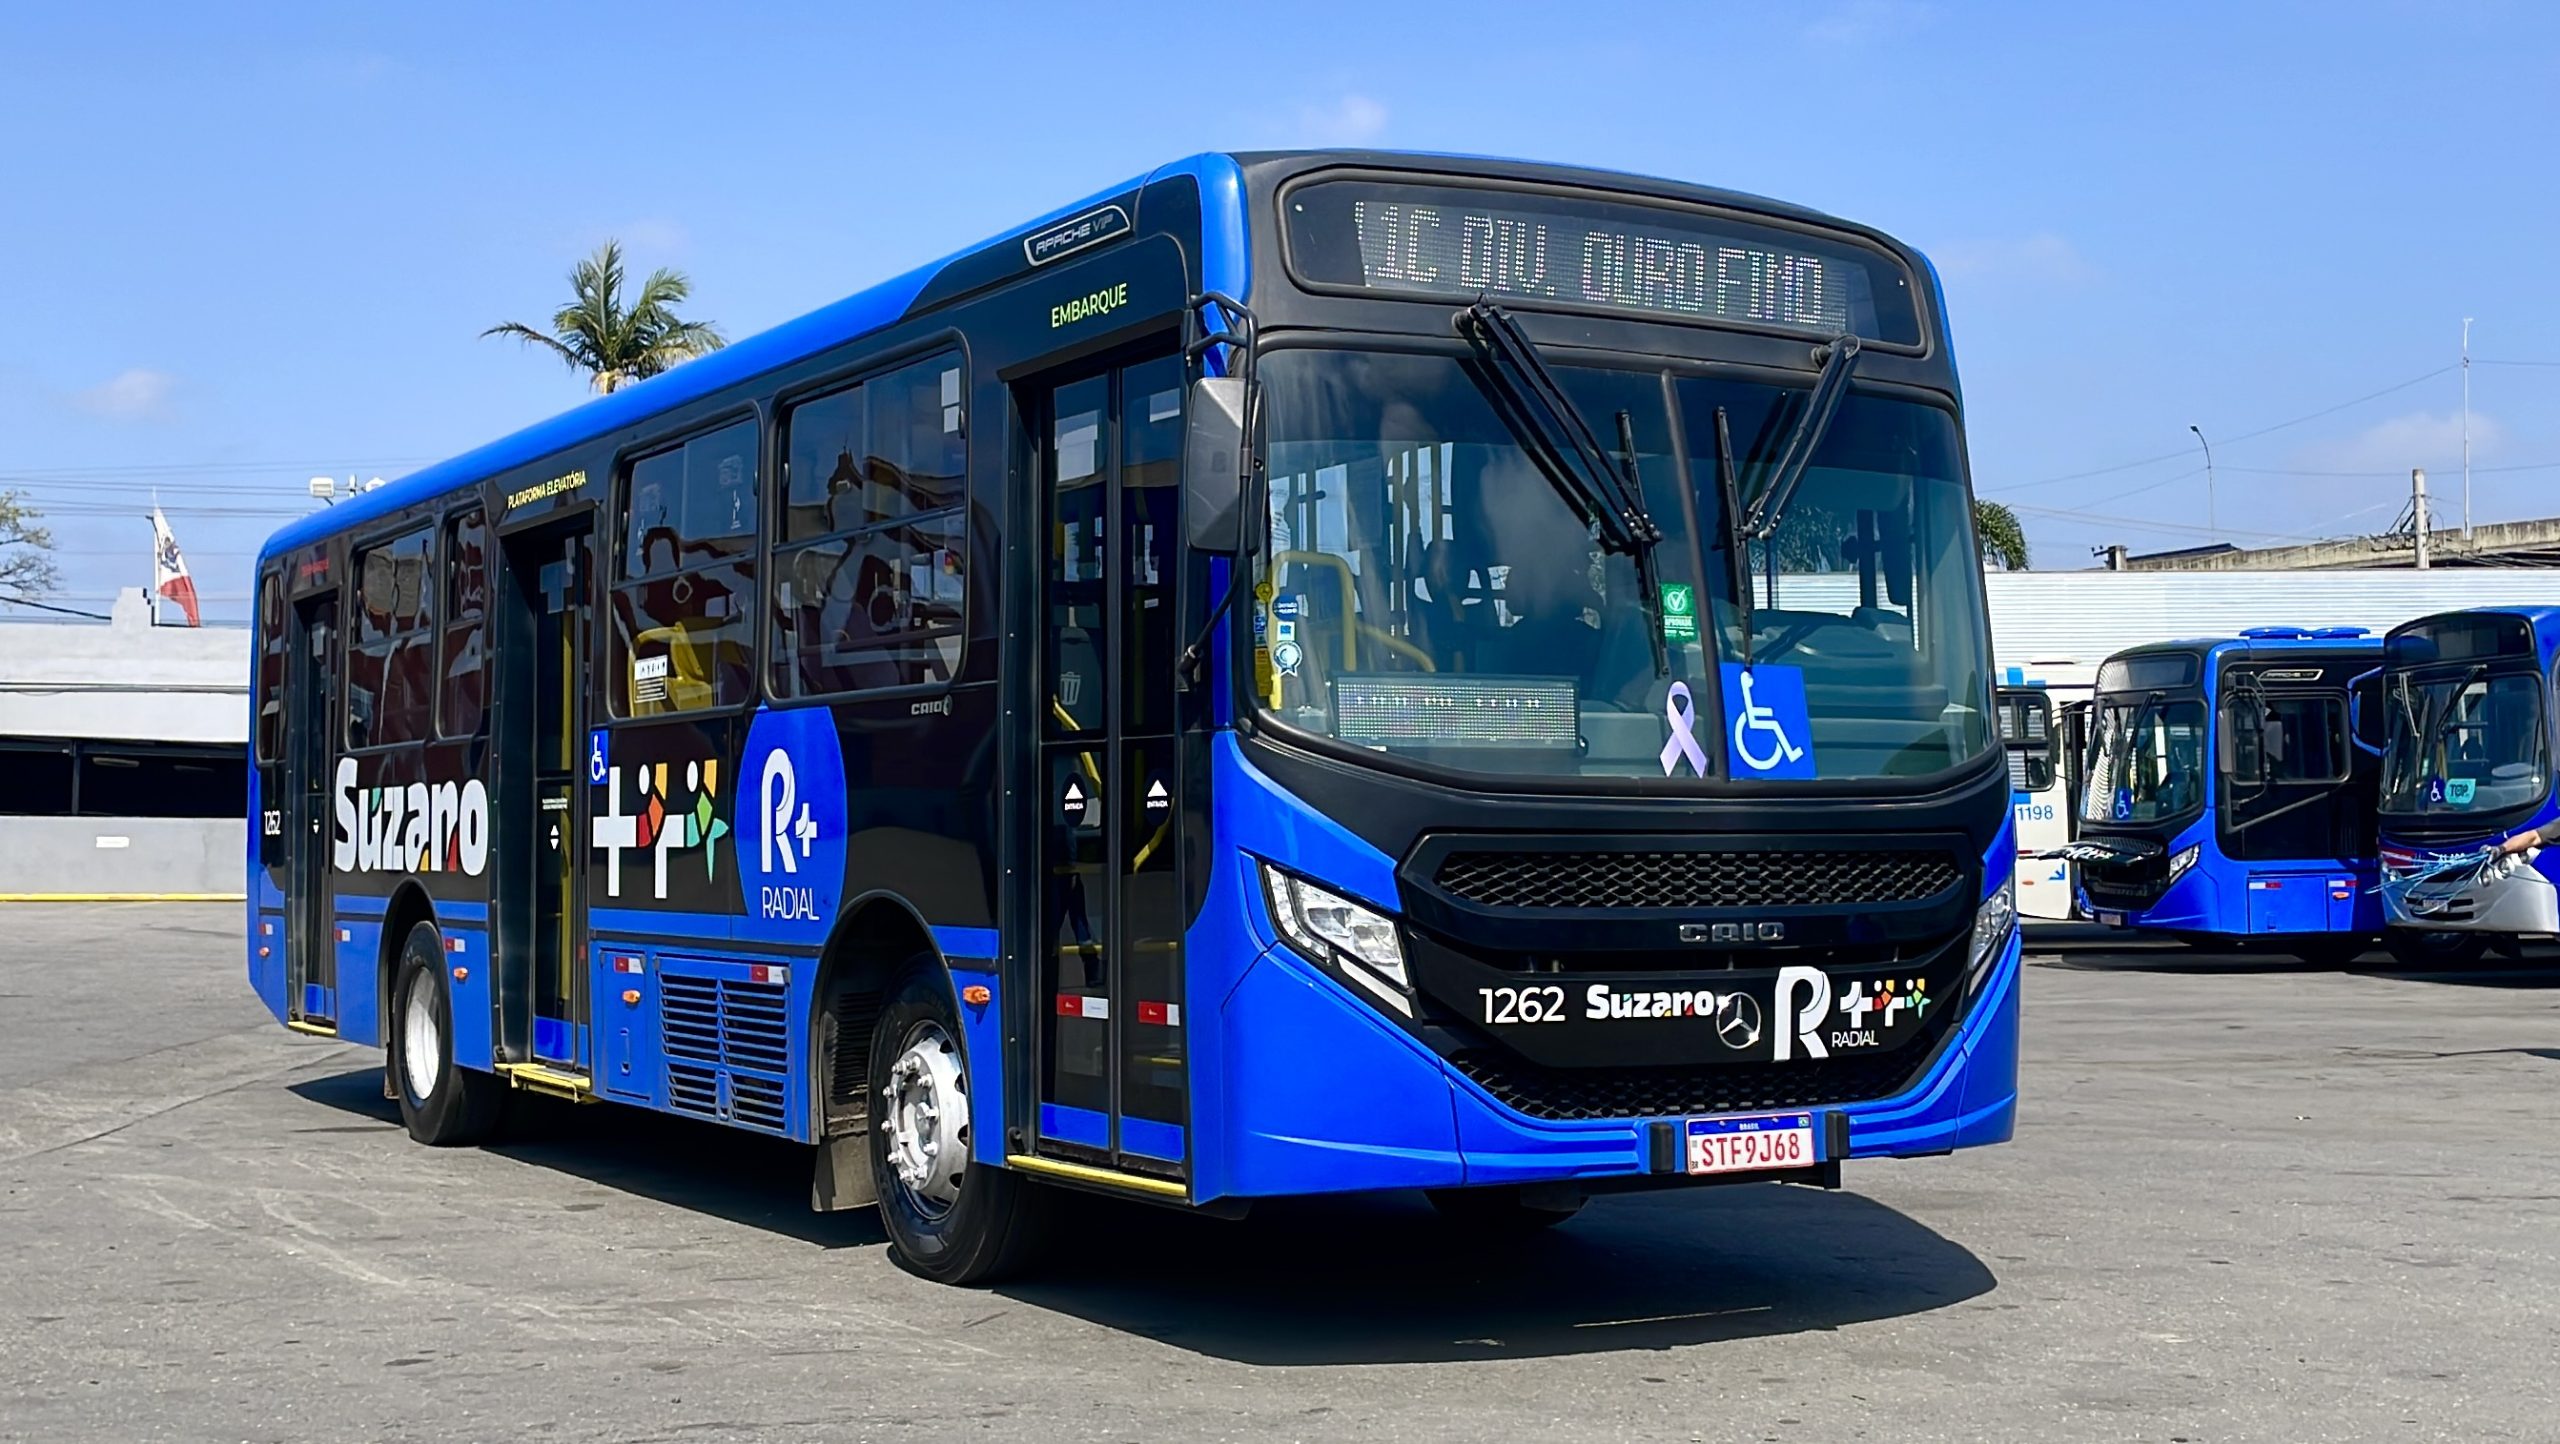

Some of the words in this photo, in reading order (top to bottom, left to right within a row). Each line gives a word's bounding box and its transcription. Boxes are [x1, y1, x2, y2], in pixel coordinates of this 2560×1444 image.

[1036, 222, 1091, 255] APACHE
[1092, 213, 1114, 233] VIP
[1582, 231, 1704, 312] OURO
[1716, 246, 1822, 324] FINO
[1051, 282, 1128, 329] EMBARQUE
[507, 483, 547, 510] PLATAFORMA
[546, 470, 586, 496] ELEVATÓRIA
[911, 700, 943, 715] CAIO
[264, 810, 281, 835] 1262
[334, 757, 489, 876] Suzano
[2016, 804, 2054, 821] 1198
[762, 886, 820, 920] RADIAL
[1679, 921, 1785, 943] CAIO
[1479, 985, 1566, 1024] 1262
[1586, 984, 1715, 1020] Suzano
[1831, 1030, 1880, 1048] RADIAL
[1701, 1132, 1800, 1167] STF9J68
